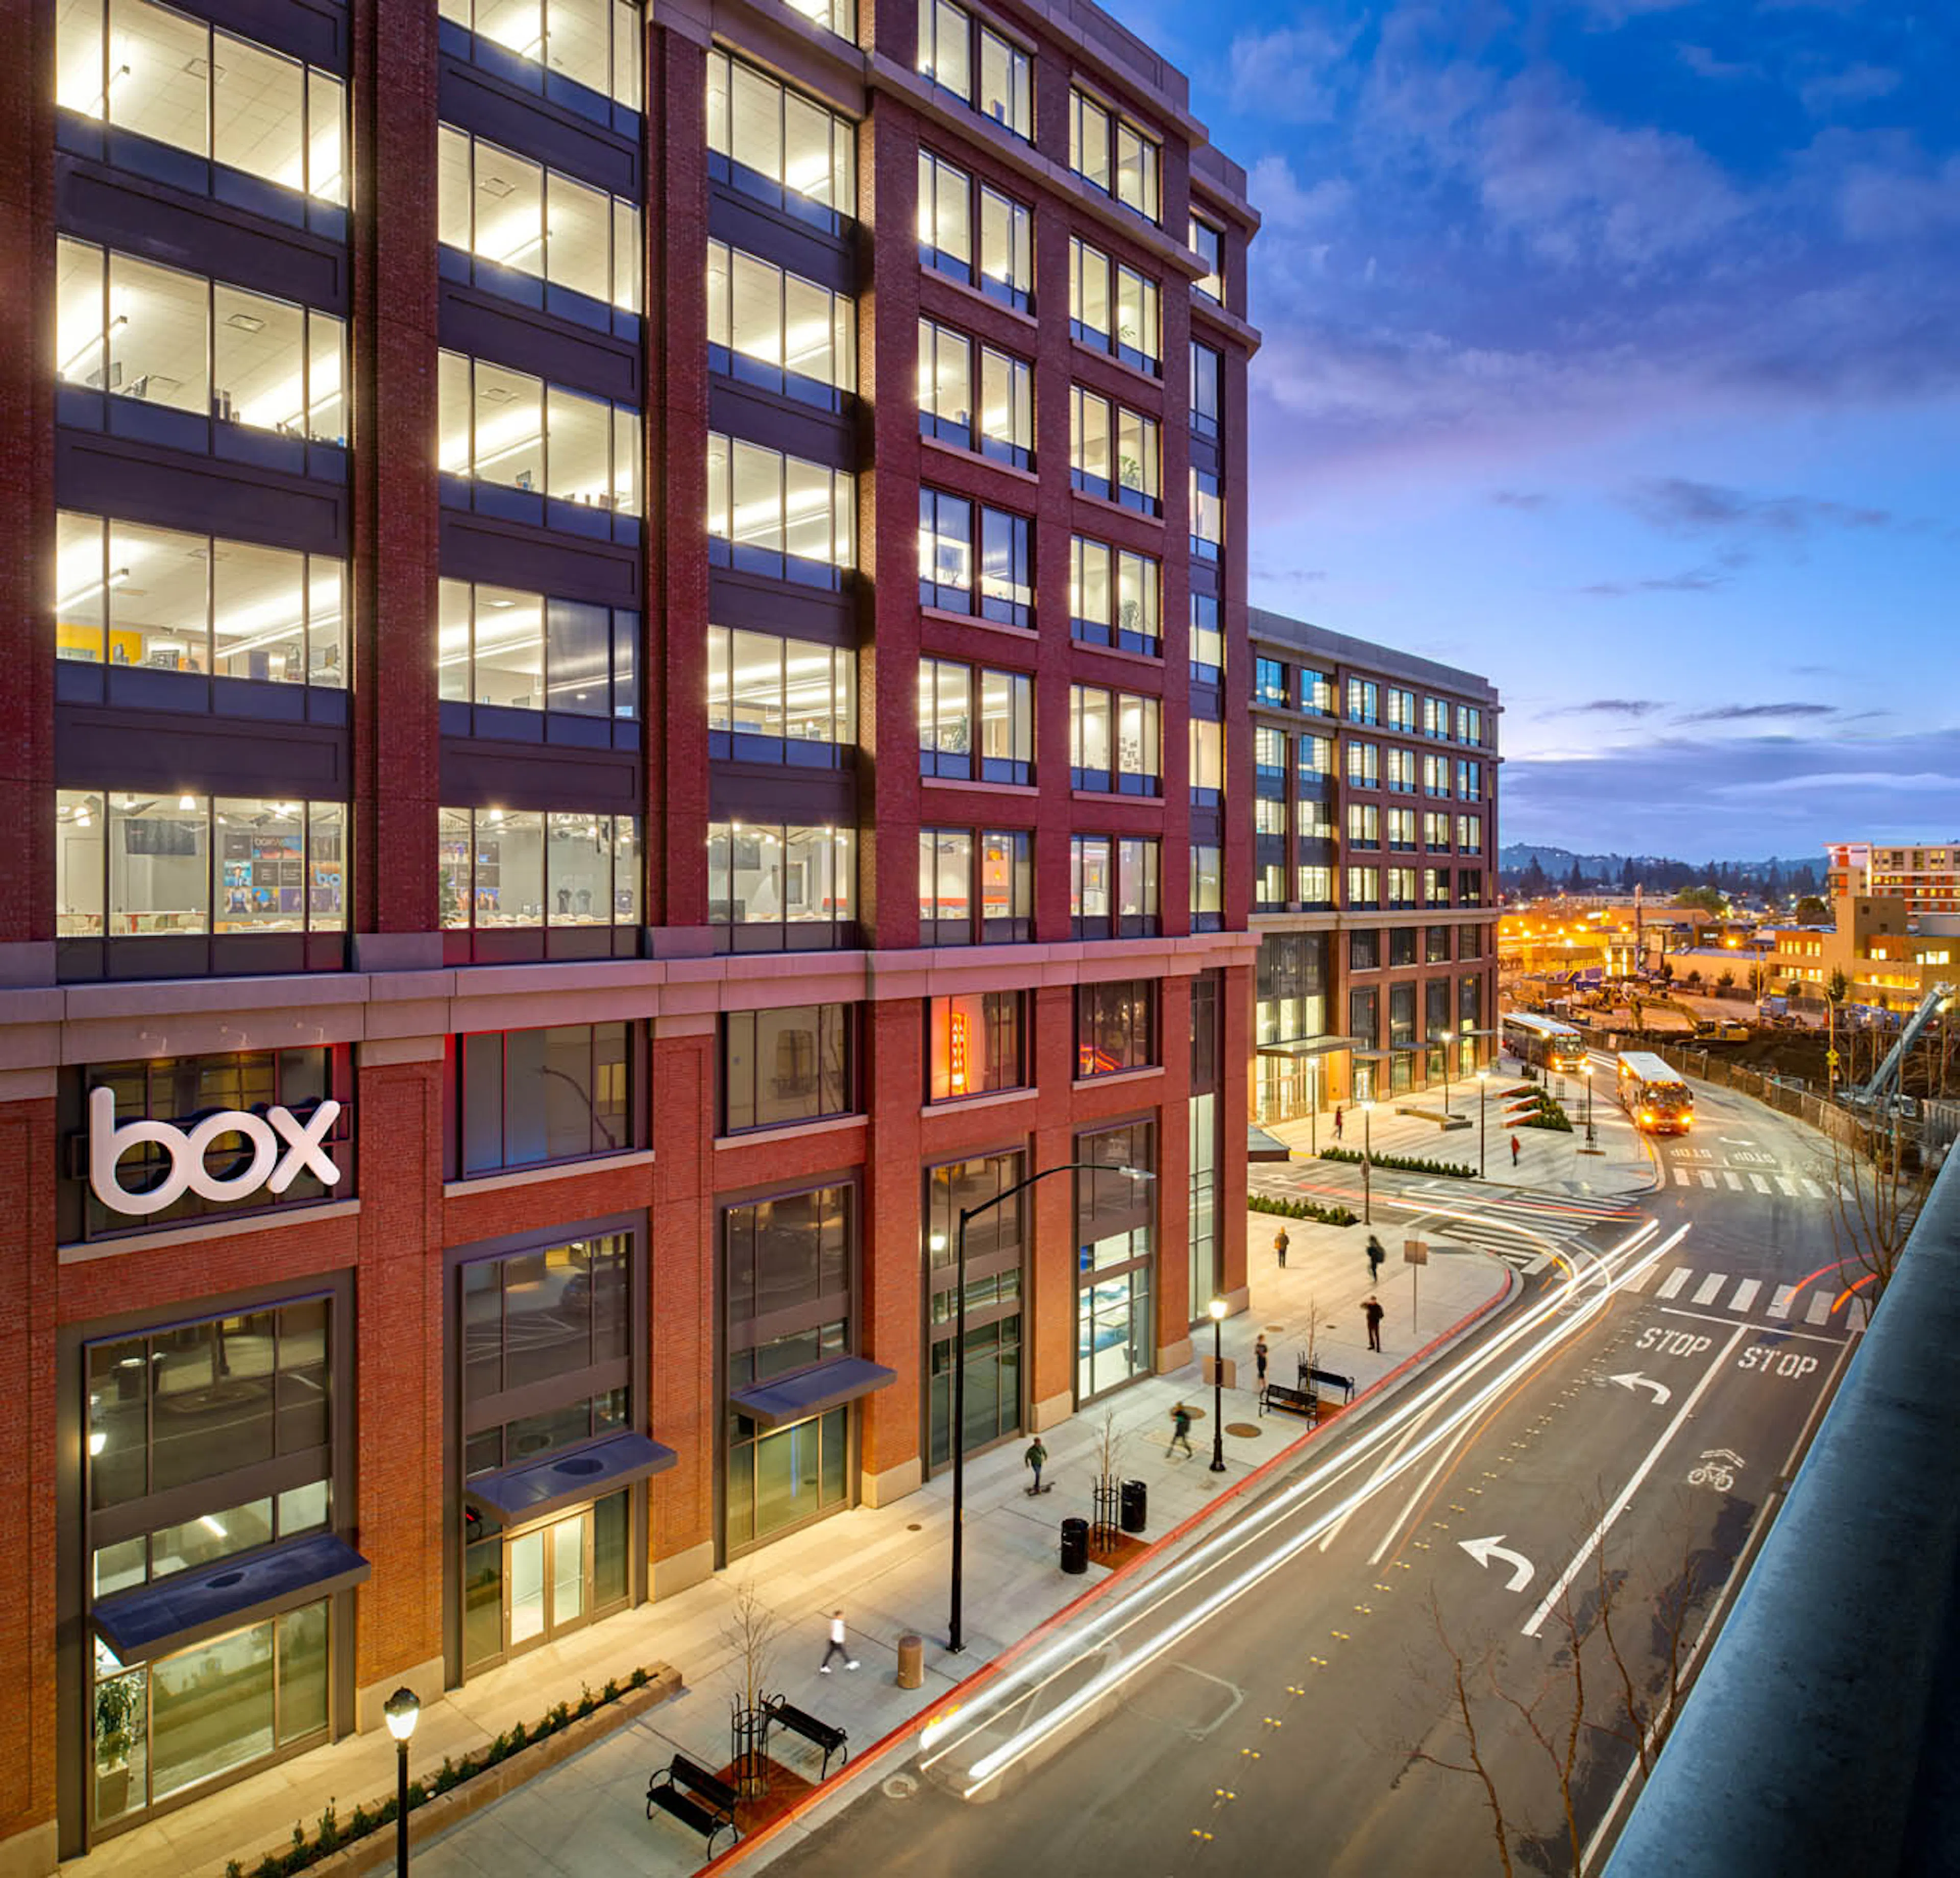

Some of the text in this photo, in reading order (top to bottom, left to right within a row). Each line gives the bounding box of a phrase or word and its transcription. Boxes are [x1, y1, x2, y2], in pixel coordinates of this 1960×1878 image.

[89, 1086, 340, 1215] box
[1635, 1327, 1712, 1358] STOP
[1737, 1347, 1819, 1380] STOP
